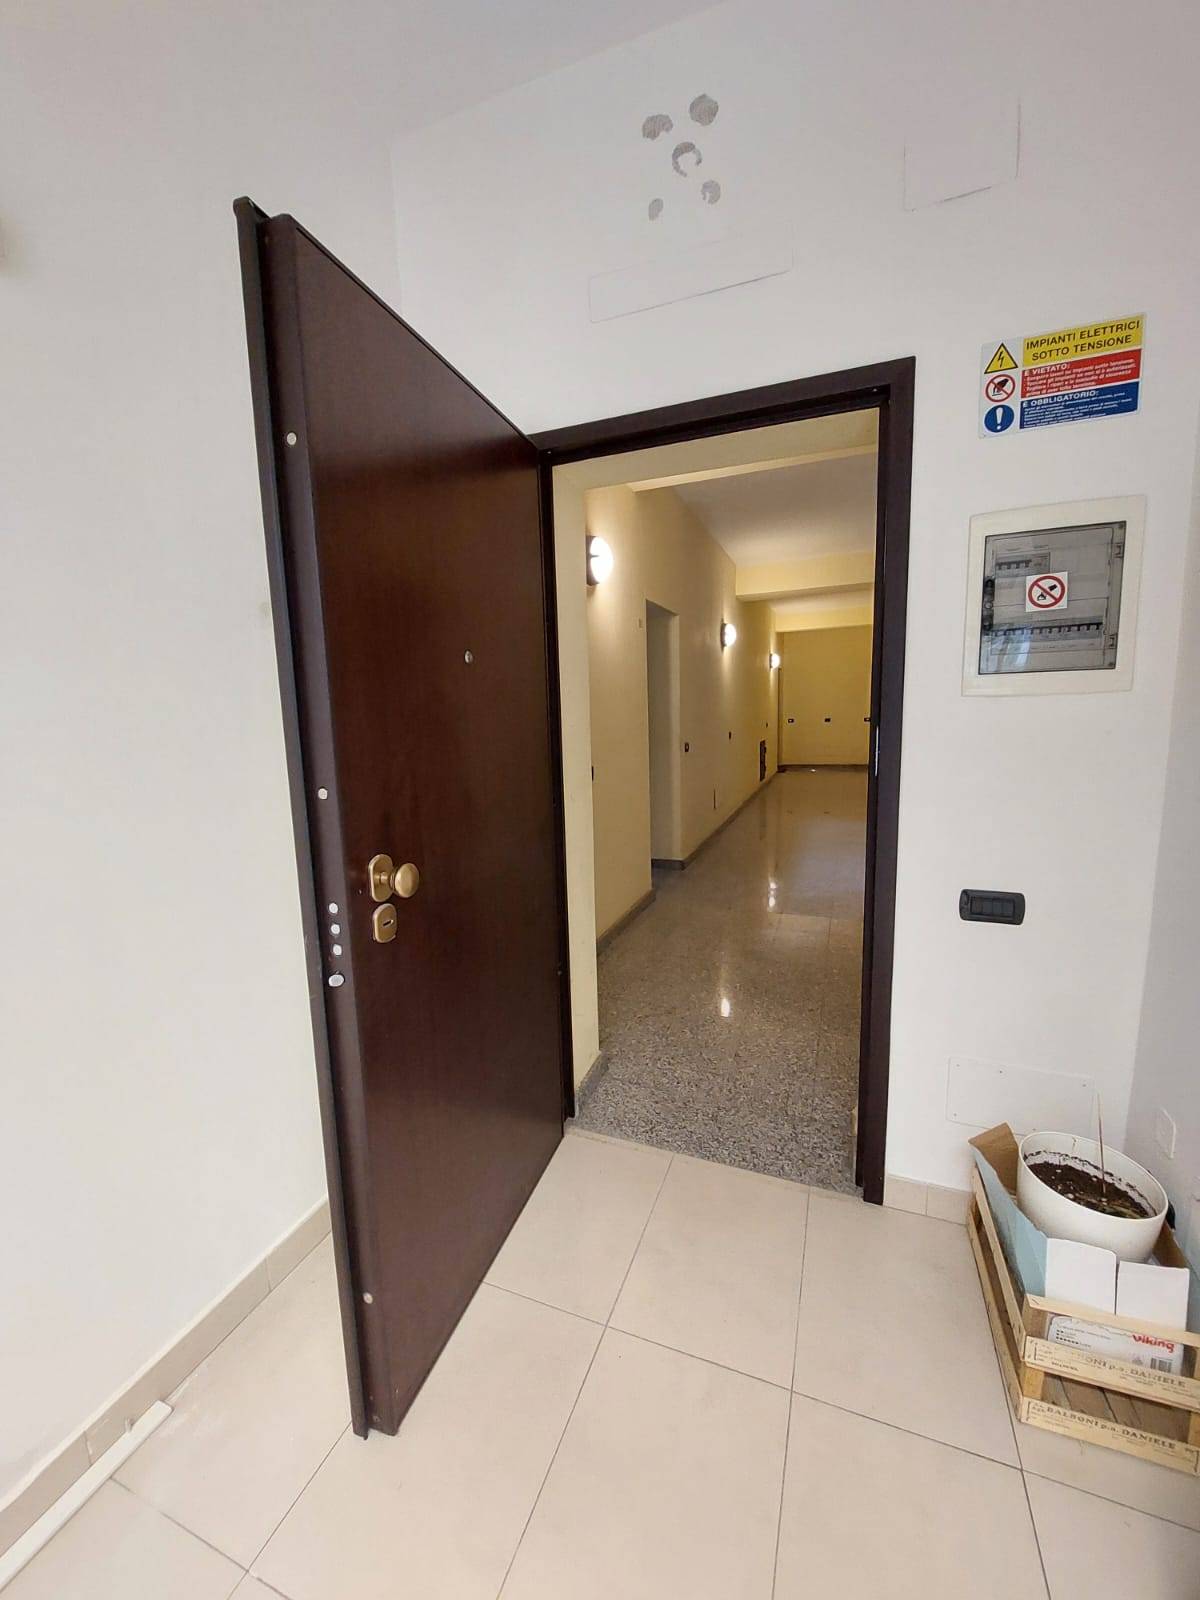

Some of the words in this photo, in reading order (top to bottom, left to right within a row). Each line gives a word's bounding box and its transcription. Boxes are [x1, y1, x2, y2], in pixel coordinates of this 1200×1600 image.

[1026, 333, 1076, 350] IMPIANTI
[1079, 320, 1140, 340] ELETTRICI
[1031, 346, 1070, 361] SOTTO
[1073, 334, 1132, 353] TENSIONE
[1032, 363, 1071, 375] VIETATO:
[1030, 390, 1099, 407] OBBLIGATORIO:
[1121, 1428, 1177, 1450] DANIELE
